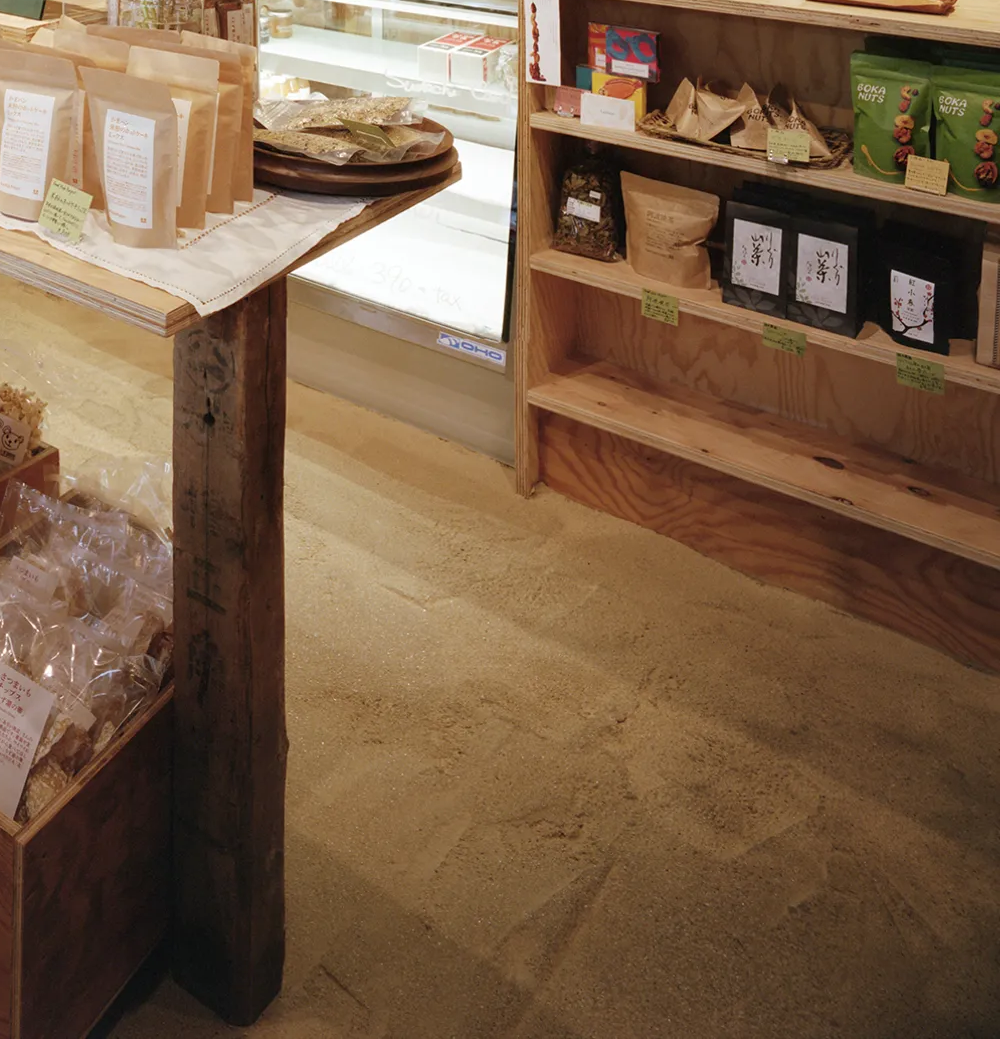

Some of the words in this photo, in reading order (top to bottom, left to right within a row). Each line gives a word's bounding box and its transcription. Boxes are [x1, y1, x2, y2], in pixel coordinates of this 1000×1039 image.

[857, 83, 887, 95] BOKA
[858, 92, 885, 104] NUTS
[938, 95, 968, 108] BOKA
[939, 105, 966, 117] NUTS
[0, 672, 32, 698] さつまいも
